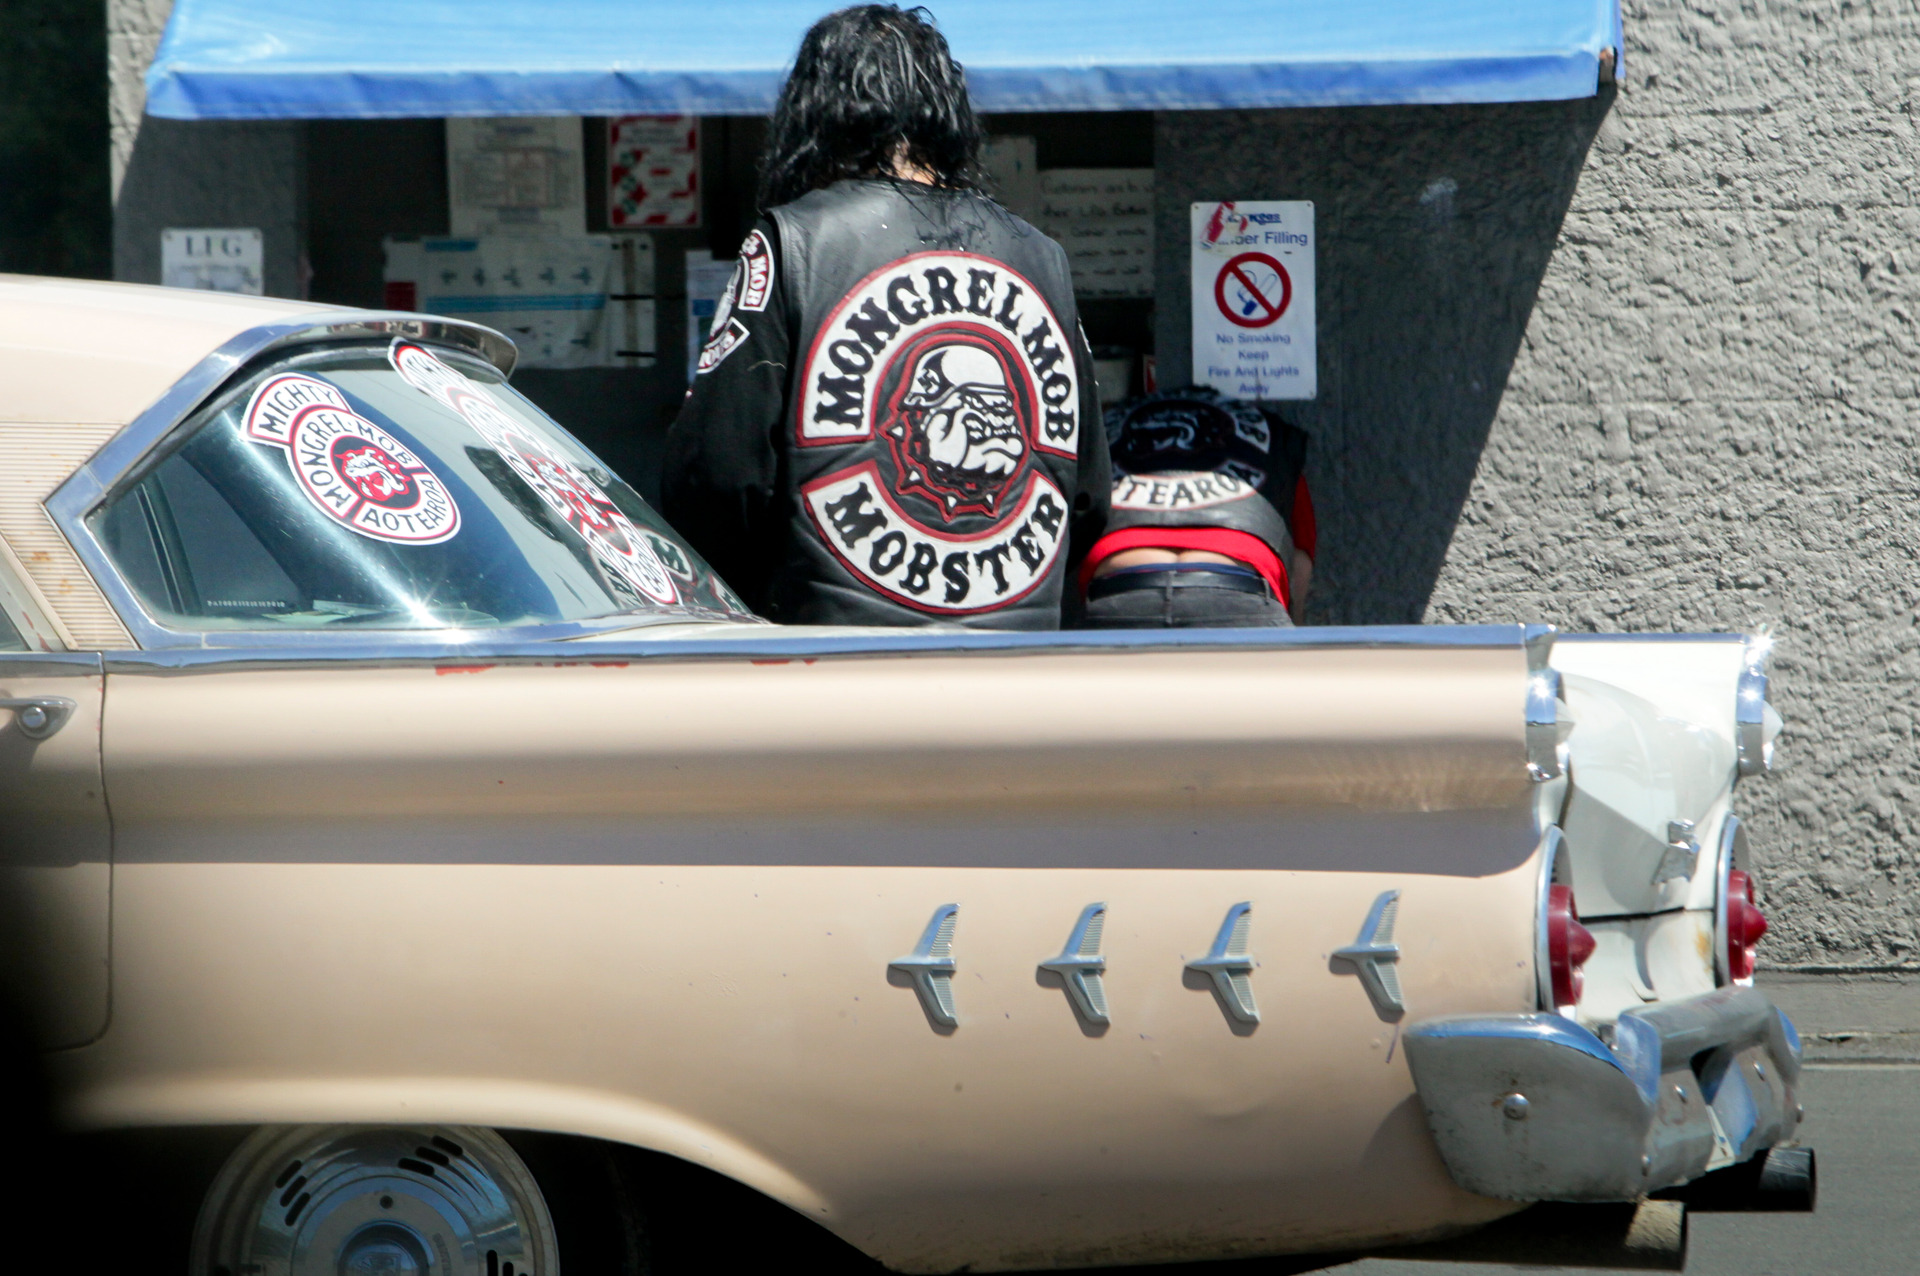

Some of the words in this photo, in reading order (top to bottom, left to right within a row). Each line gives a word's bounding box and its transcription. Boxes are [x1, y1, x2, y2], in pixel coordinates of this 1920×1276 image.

[1264, 231, 1308, 247] Filling
[1216, 333, 1234, 344] No
[1237, 333, 1291, 344] Smoking
[813, 266, 1024, 429] MONGREL
[1022, 316, 1075, 443] MOB
[1238, 350, 1269, 360] Keep
[1208, 365, 1231, 377] Fire
[1235, 365, 1259, 376] And
[1262, 365, 1299, 378] Lights
[1238, 383, 1270, 395] Away
[258, 383, 338, 435] MIGHTY
[361, 478, 447, 533] AOTEAROA
[824, 481, 1065, 604] MOBSTER
